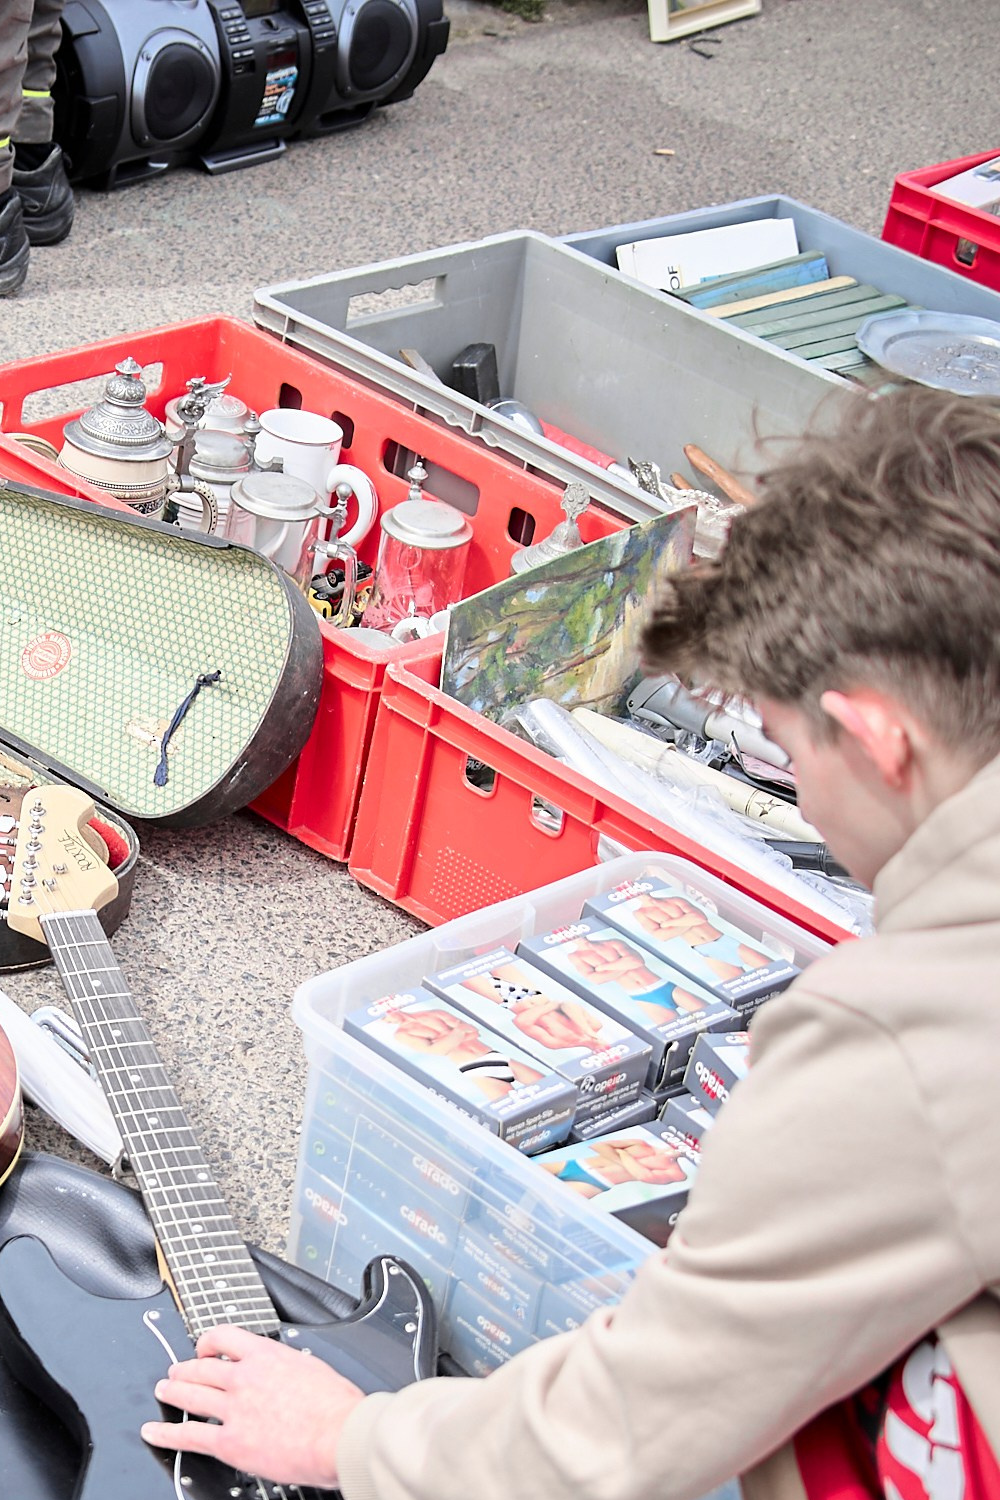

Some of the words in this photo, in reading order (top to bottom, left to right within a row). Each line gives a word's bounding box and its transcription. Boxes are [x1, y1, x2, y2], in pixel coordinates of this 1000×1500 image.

[607, 881, 654, 902] carado
[543, 924, 592, 944] carado
[580, 1044, 630, 1068] carado
[593, 1072, 628, 1093] carado
[694, 1061, 730, 1104] carado
[518, 1129, 552, 1150] carado
[412, 1155, 460, 1196] carado
[303, 1187, 348, 1226] carado
[400, 1204, 447, 1245] carado
[477, 1271, 511, 1300] carado
[476, 1315, 512, 1345] carado
